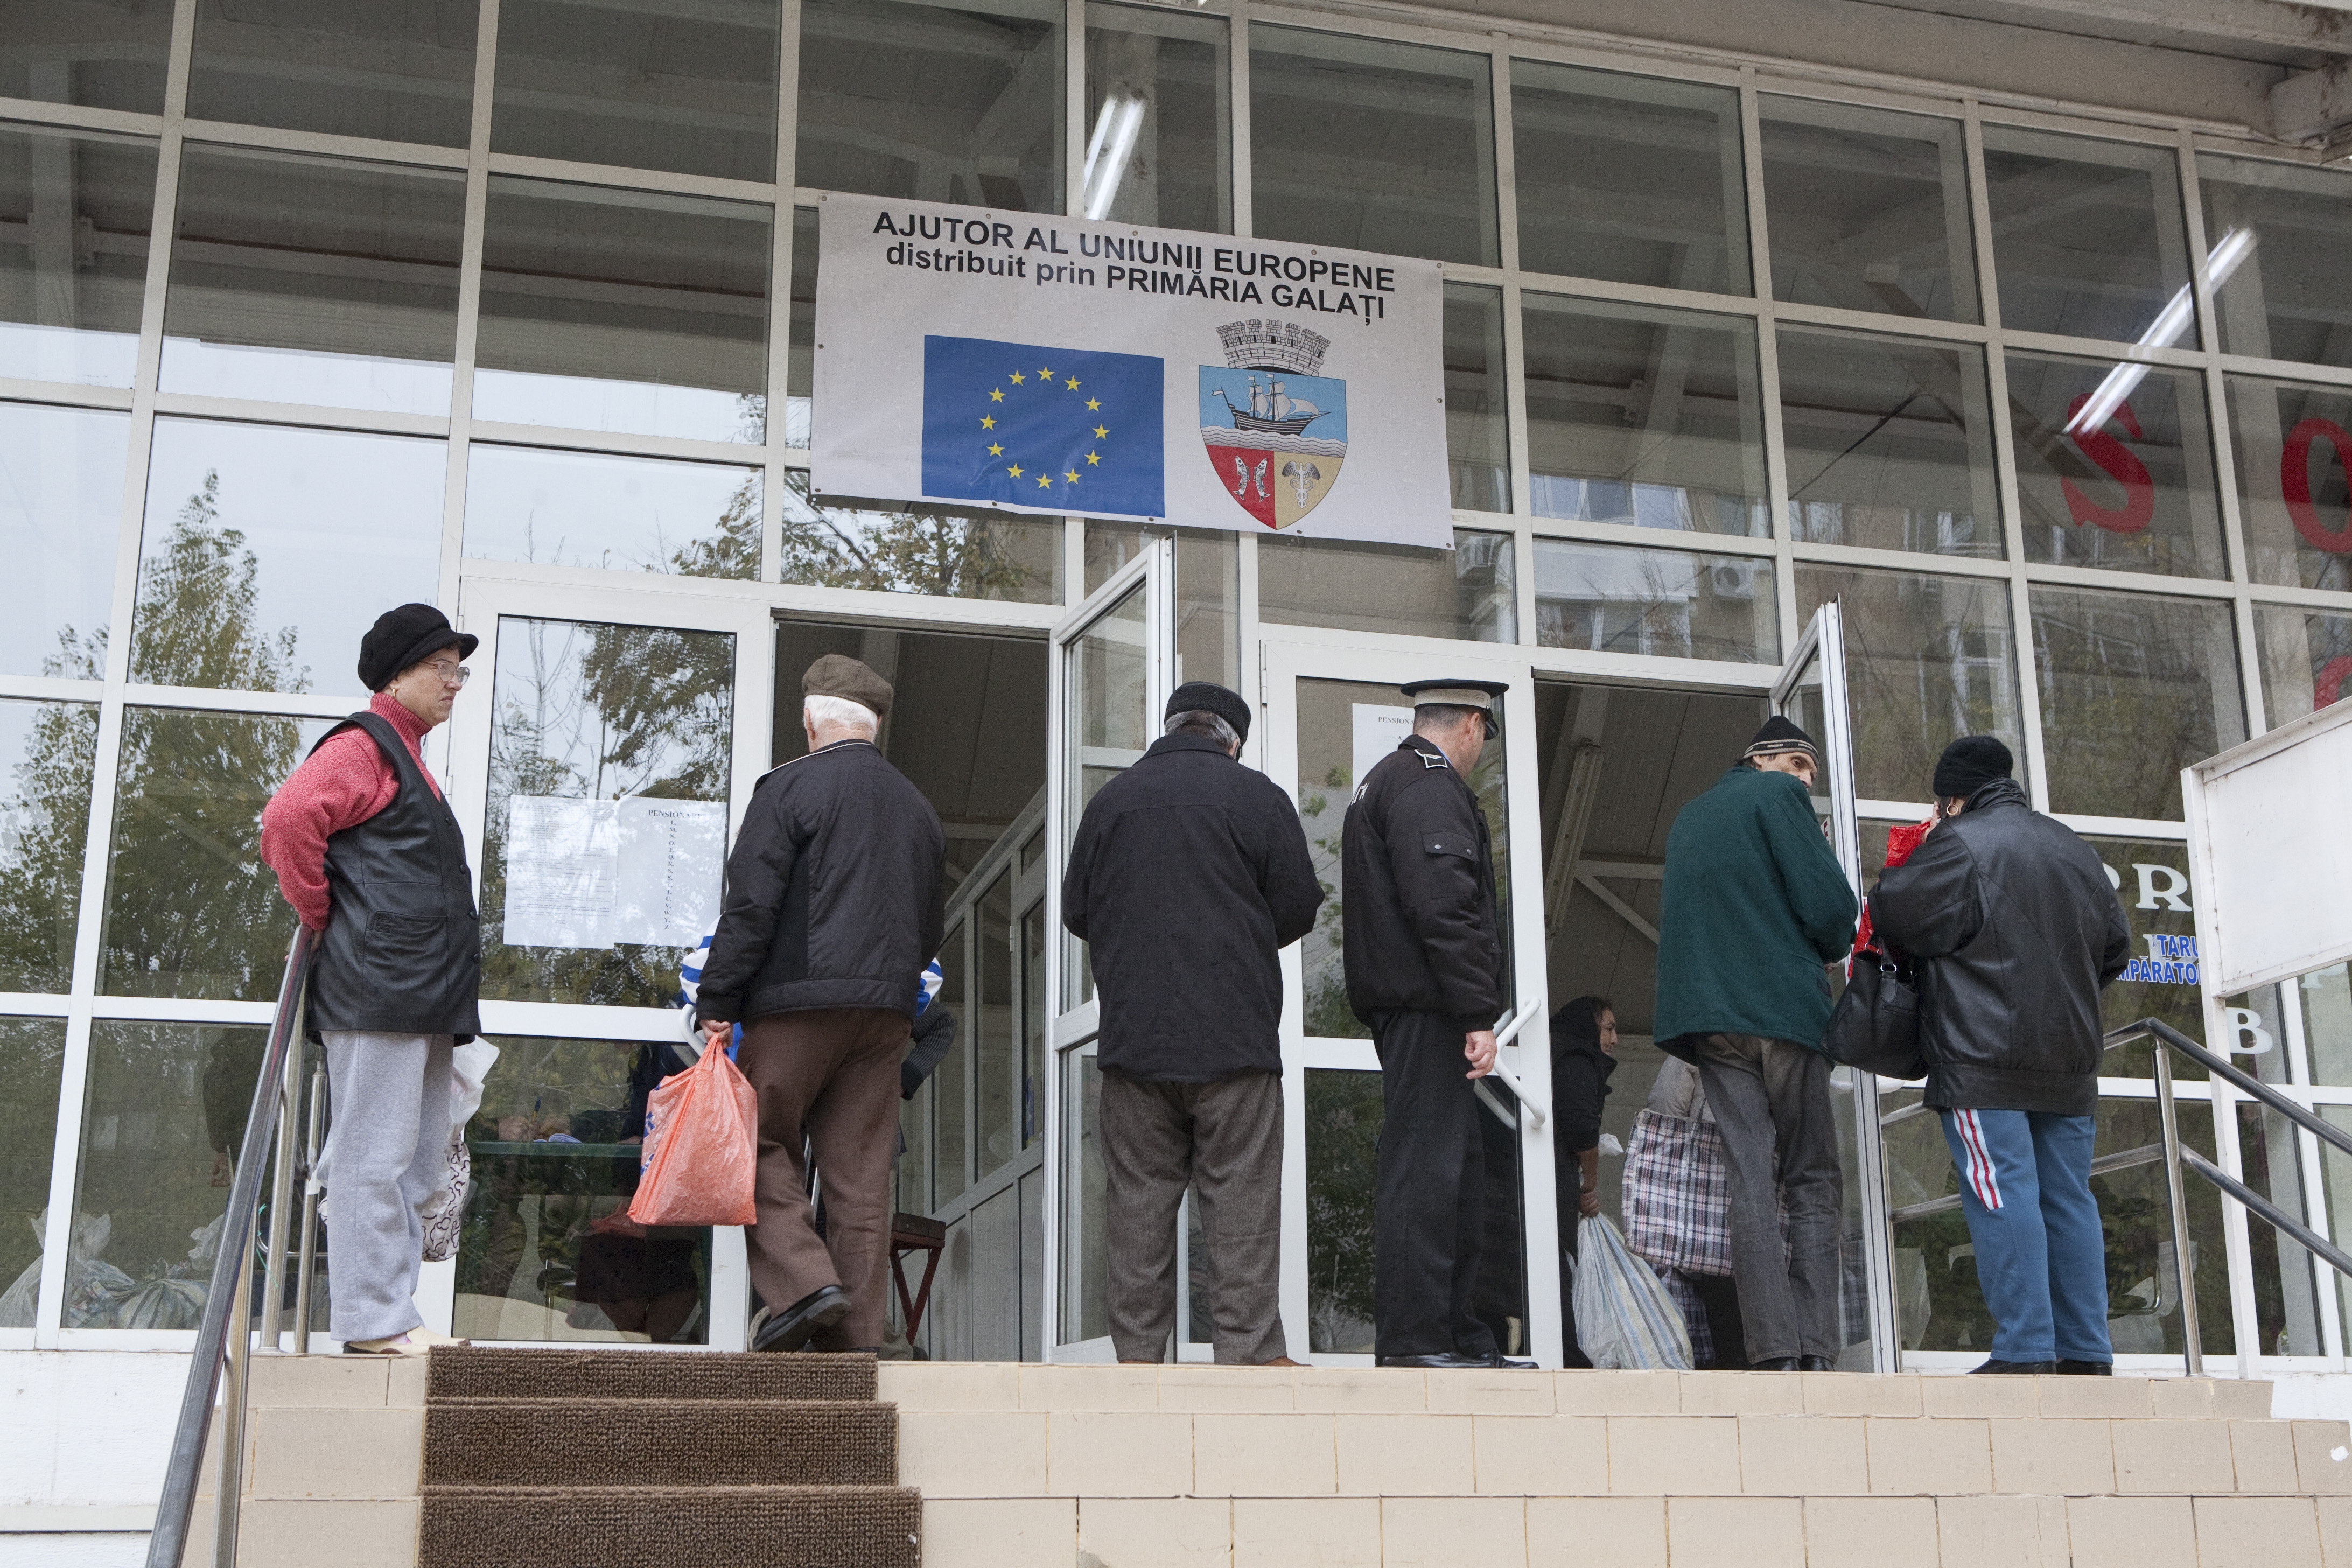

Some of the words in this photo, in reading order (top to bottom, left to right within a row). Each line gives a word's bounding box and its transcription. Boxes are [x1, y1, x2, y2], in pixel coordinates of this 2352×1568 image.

[873, 212, 1014, 248] AJUTOR
[1024, 228, 1068, 254] AL
[1080, 233, 1201, 269] UNIUNII
[1215, 249, 1395, 292] EUROPENE
[887, 242, 1025, 277] distribuit
[1037, 260, 1094, 285] prin
[1108, 265, 1263, 304] PRIMĂRIA
[1272, 285, 1383, 326] GALAȚI
[1378, 716, 1414, 724] PENSIONA
